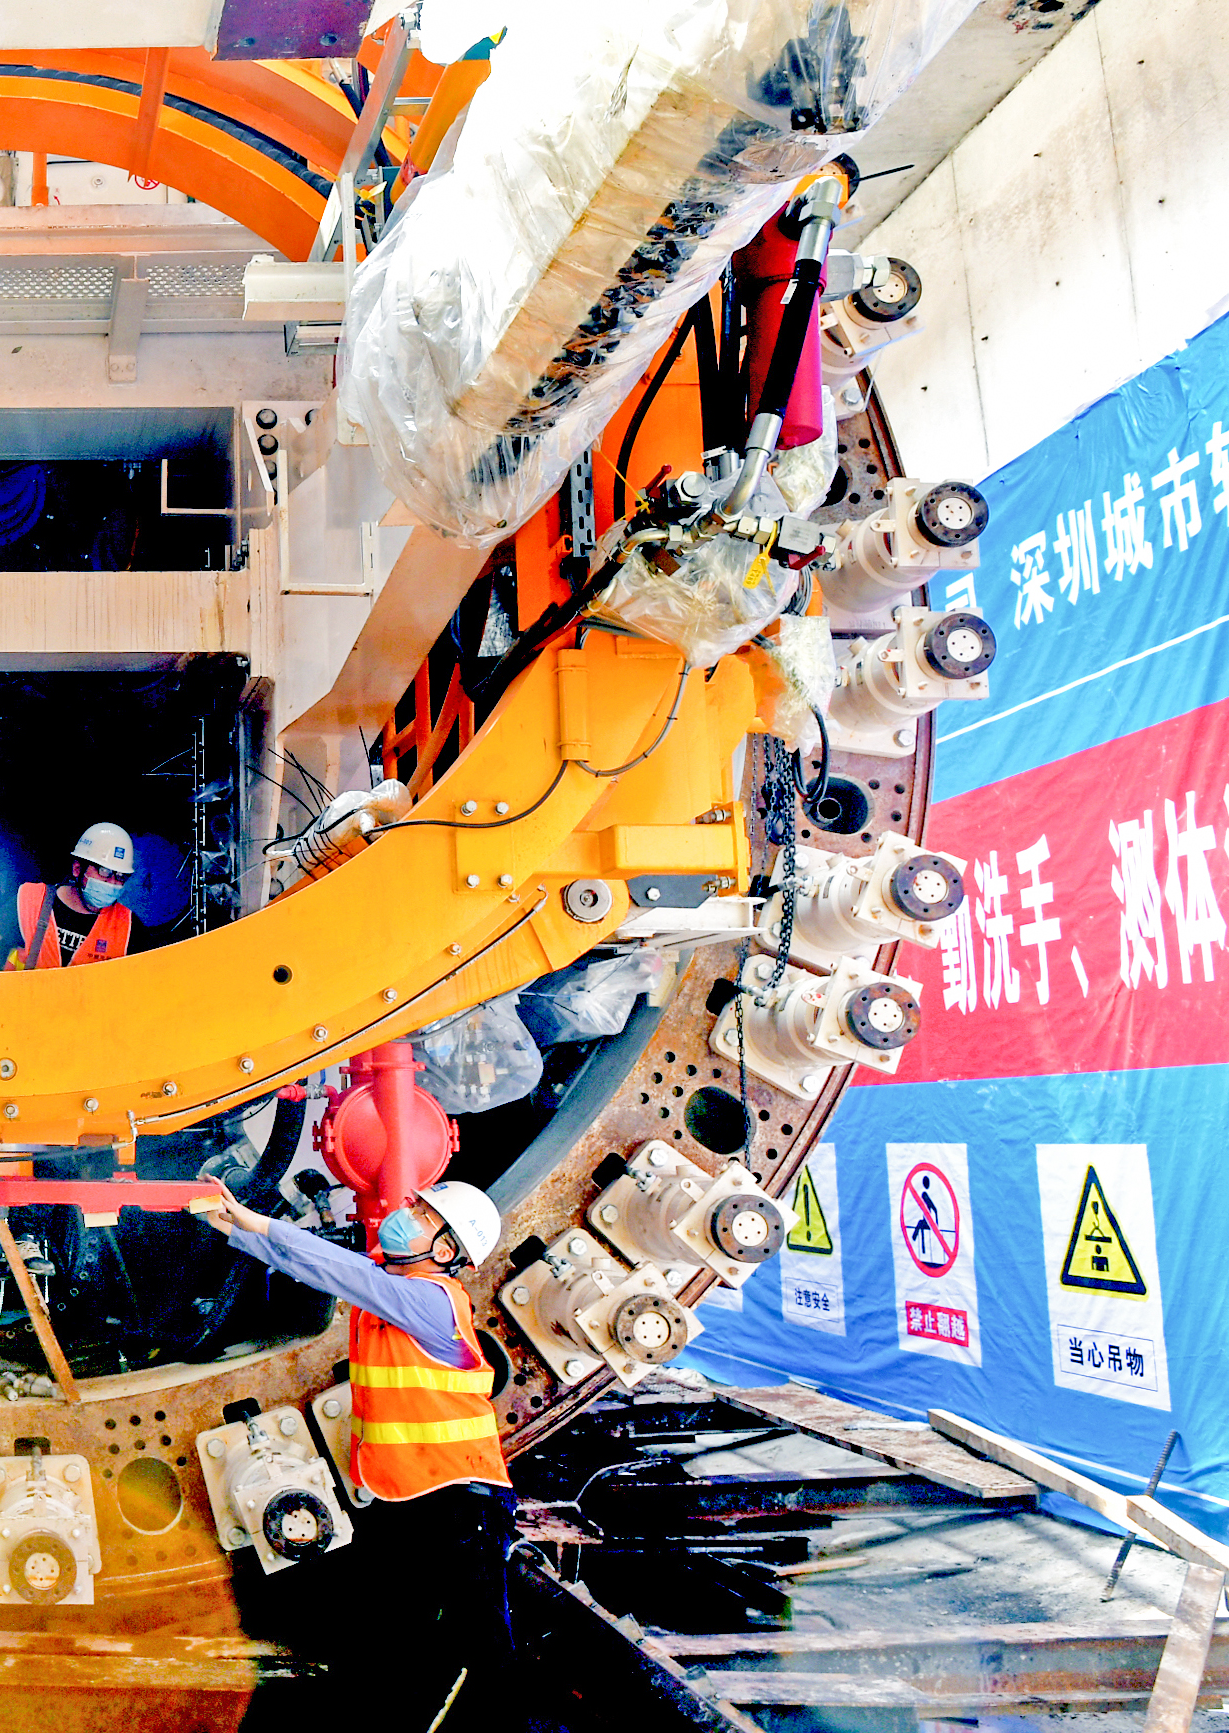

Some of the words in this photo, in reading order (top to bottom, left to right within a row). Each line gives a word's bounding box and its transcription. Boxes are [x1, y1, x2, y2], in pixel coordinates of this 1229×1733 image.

[939, 783, 1229, 1016] 勤洗手、测体
[794, 1287, 831, 1312] 注意安全
[909, 1306, 966, 1341] 禁止翻越
[1069, 1337, 1144, 1377] 当心吊物
